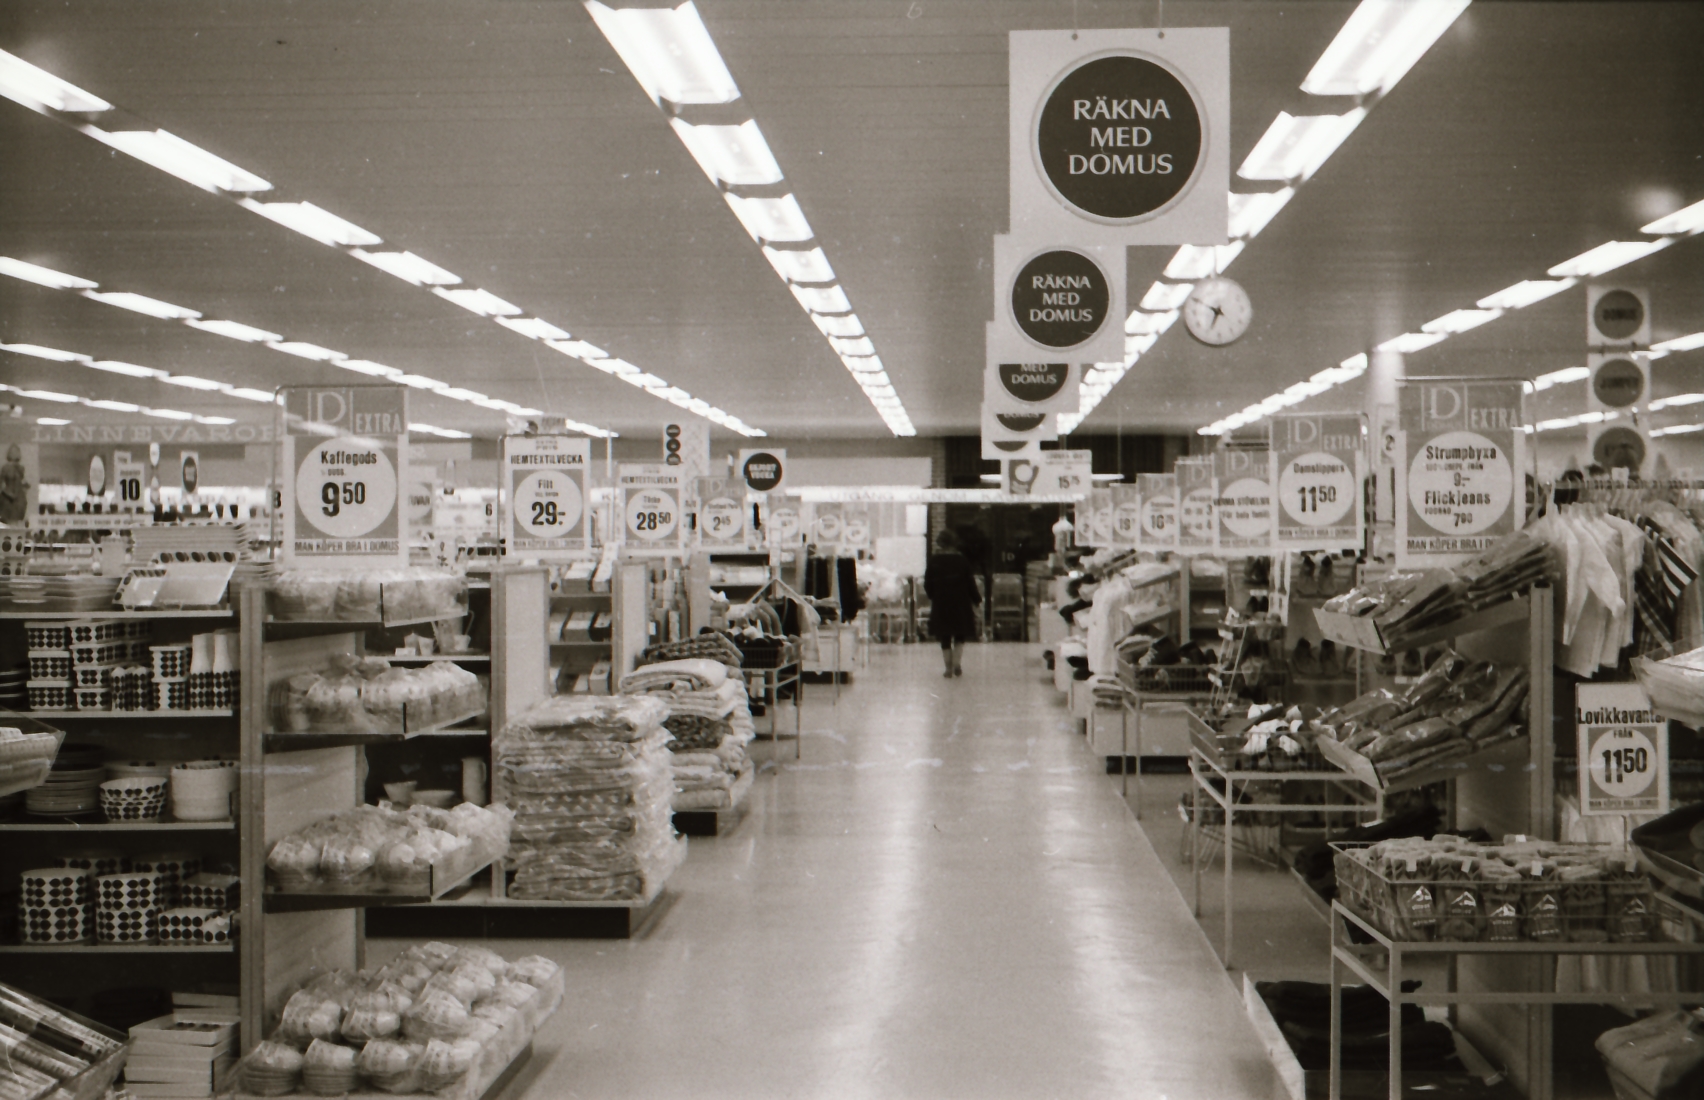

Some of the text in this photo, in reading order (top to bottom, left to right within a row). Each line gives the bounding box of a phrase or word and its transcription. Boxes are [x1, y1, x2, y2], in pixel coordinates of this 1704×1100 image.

[1073, 95, 1171, 120] RÄKNA
[1090, 126, 1152, 147] MED
[1069, 153, 1173, 175] DOMUS
[1032, 273, 1092, 289] RÄKNA
[1042, 291, 1080, 306] MED
[1029, 308, 1093, 322] DOMUS
[1011, 373, 1057, 384] DOMUS
[356, 413, 402, 433] EXTRA
[1471, 408, 1518, 429] EXTRA
[1324, 434, 1358, 450] EXTRA
[321, 450, 378, 466] Kaffegods
[511, 454, 584, 465] HEMTEXTILVECKA
[1426, 445, 1496, 461] Strumpbyxa
[1293, 463, 1345, 475] Damslippers
[120, 478, 141, 501] 10
[1425, 490, 1491, 507] Flickjeans
[295, 541, 314, 552] MAN
[316, 539, 343, 552] KÖPER
[346, 541, 362, 552] BRA
[370, 541, 400, 552] DOMUS
[1407, 540, 1427, 550] MAN
[1430, 538, 1458, 550] KÖPER
[1461, 539, 1478, 550] BRA
[1614, 727, 1634, 738] FRÅN
